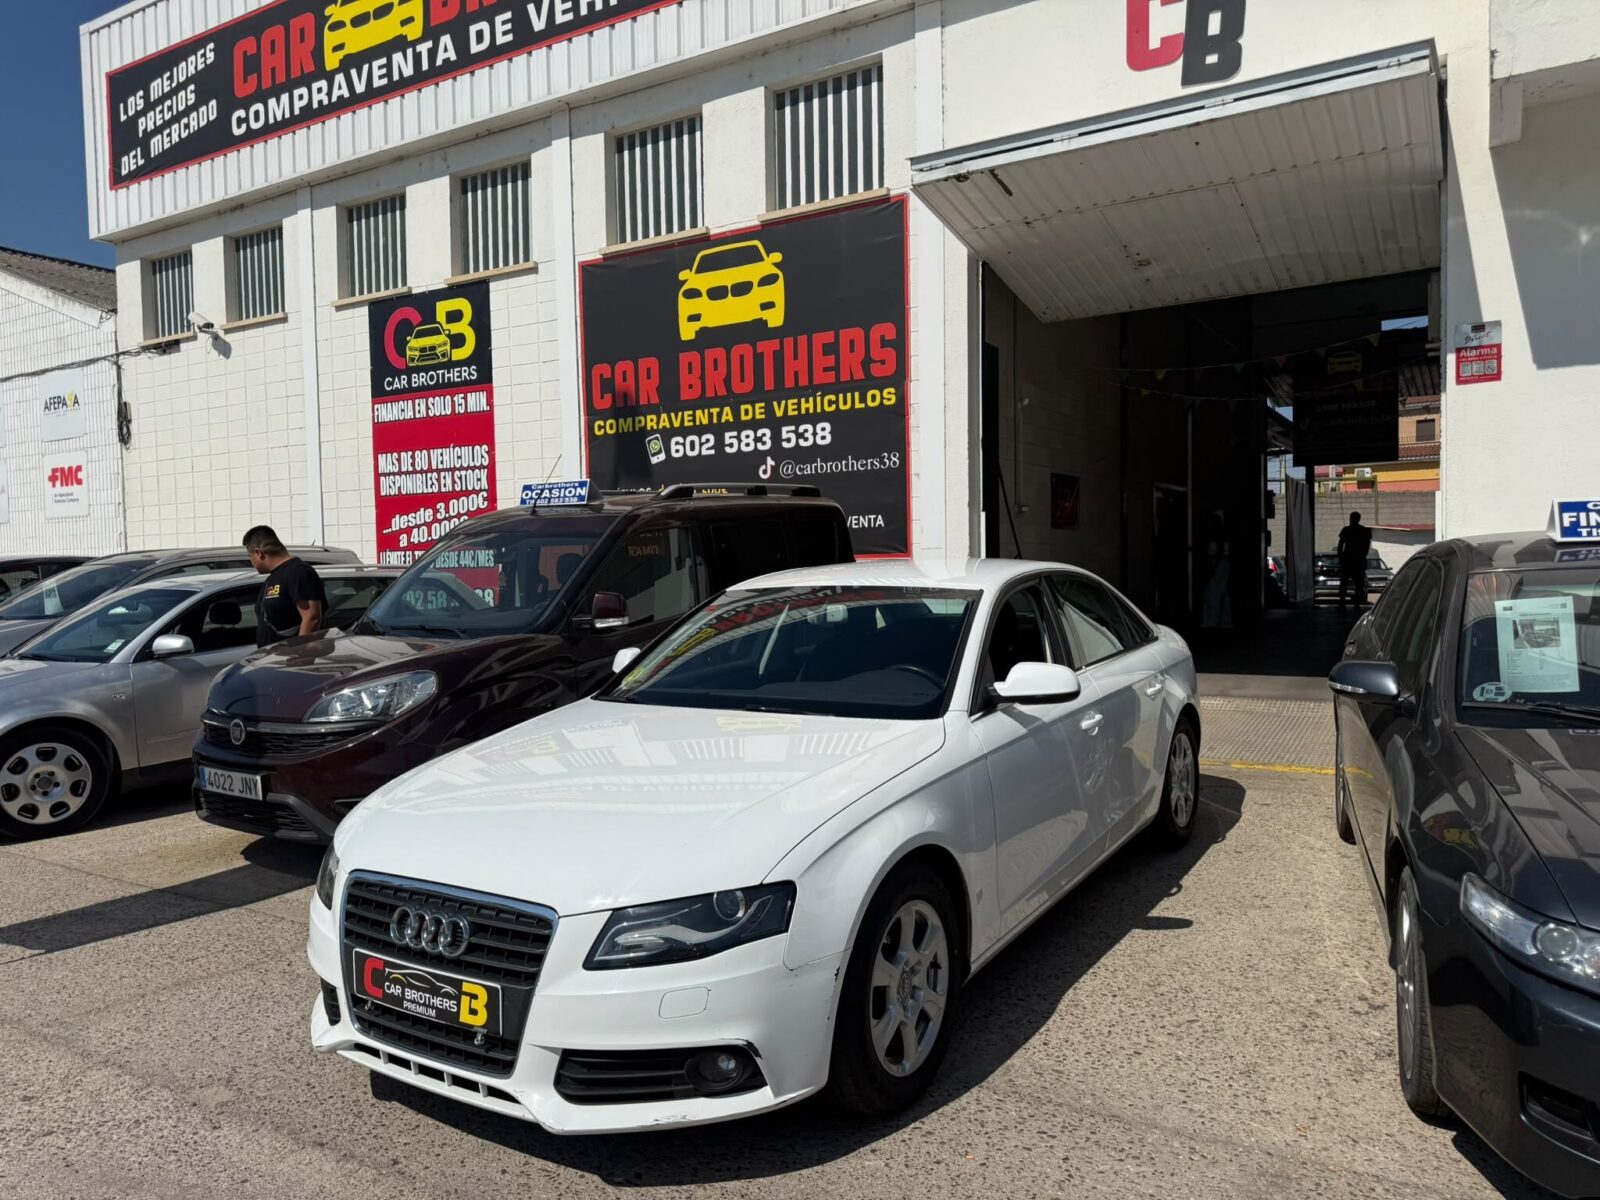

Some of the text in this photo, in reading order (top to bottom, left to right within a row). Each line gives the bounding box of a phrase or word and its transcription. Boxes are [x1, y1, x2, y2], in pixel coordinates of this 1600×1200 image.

[231, 33, 457, 137] COMPRAVENTA
[469, 11, 513, 54] DE
[527, 0, 618, 32] VEH
[232, 12, 316, 98] CAR
[119, 43, 215, 122] LOS MEJORES
[138, 84, 196, 138] PRECIOS
[121, 99, 218, 176] DEL MERCADO
[592, 322, 897, 410] CAR BROTHERS
[1460, 347, 1498, 357] Alarma
[384, 365, 477, 391] CAR BROTHERS
[374, 391, 490, 423] FINANCIA EN SOLO 15 MIN.
[594, 387, 897, 436] COMPRAVENTA DE VEHÍCULOS
[670, 422, 832, 458] 602 583 538
[378, 443, 489, 474] MAS DE 80 VEHÍCULOS
[779, 451, 900, 478] @carbrothers38
[48, 465, 83, 488] FMC
[380, 469, 488, 496] DISPONIBLES EN STOCK
[436, 491, 488, 519] 3.000€
[522, 487, 586, 499] OCASION
[399, 515, 469, 547] a 40.00
[208, 771, 259, 796] 4022 JNY
[384, 982, 458, 1012] CAR BROTHERS
[403, 1001, 436, 1018] PREMIUM
